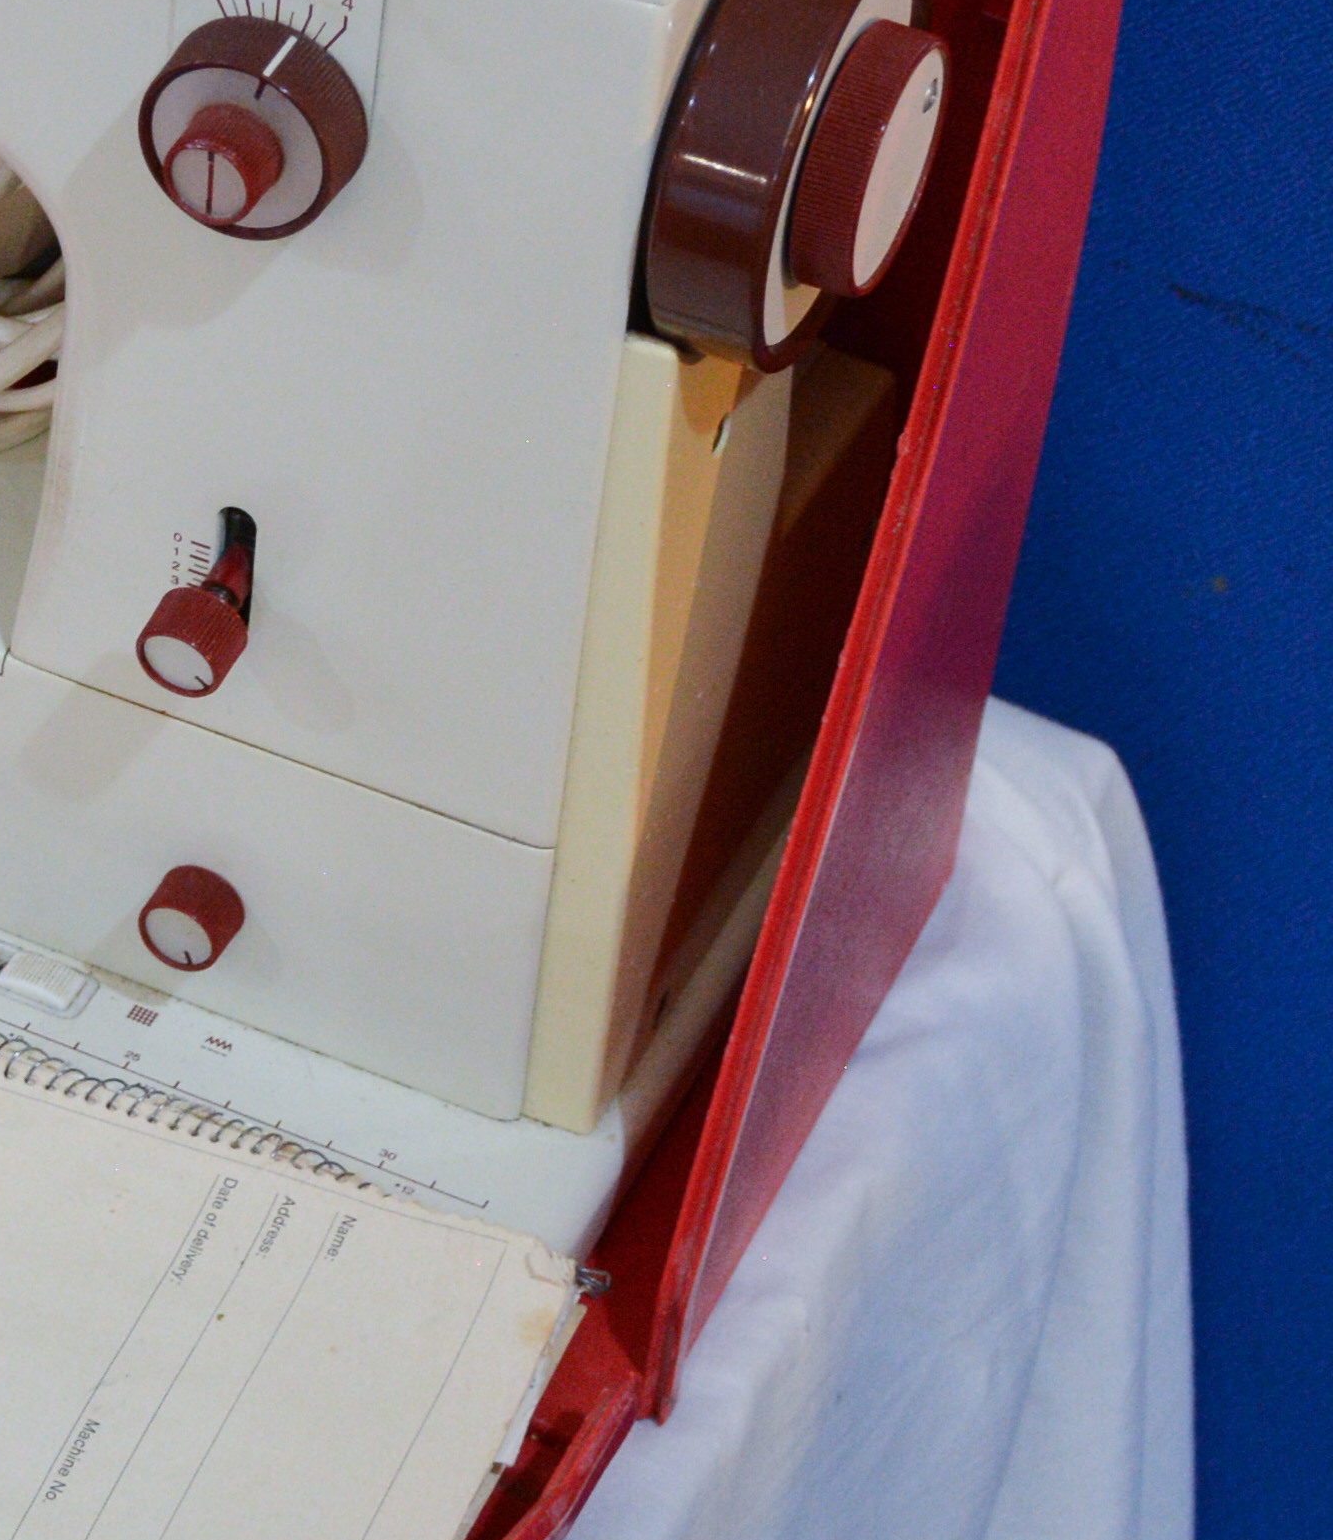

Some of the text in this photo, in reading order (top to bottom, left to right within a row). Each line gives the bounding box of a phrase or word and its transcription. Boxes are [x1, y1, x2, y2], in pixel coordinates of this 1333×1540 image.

[167, 1175, 239, 1286] Date of delivery:
[255, 1194, 296, 1256] Address:
[323, 1213, 358, 1265] Name:
[42, 1417, 101, 1505] Machine No.
